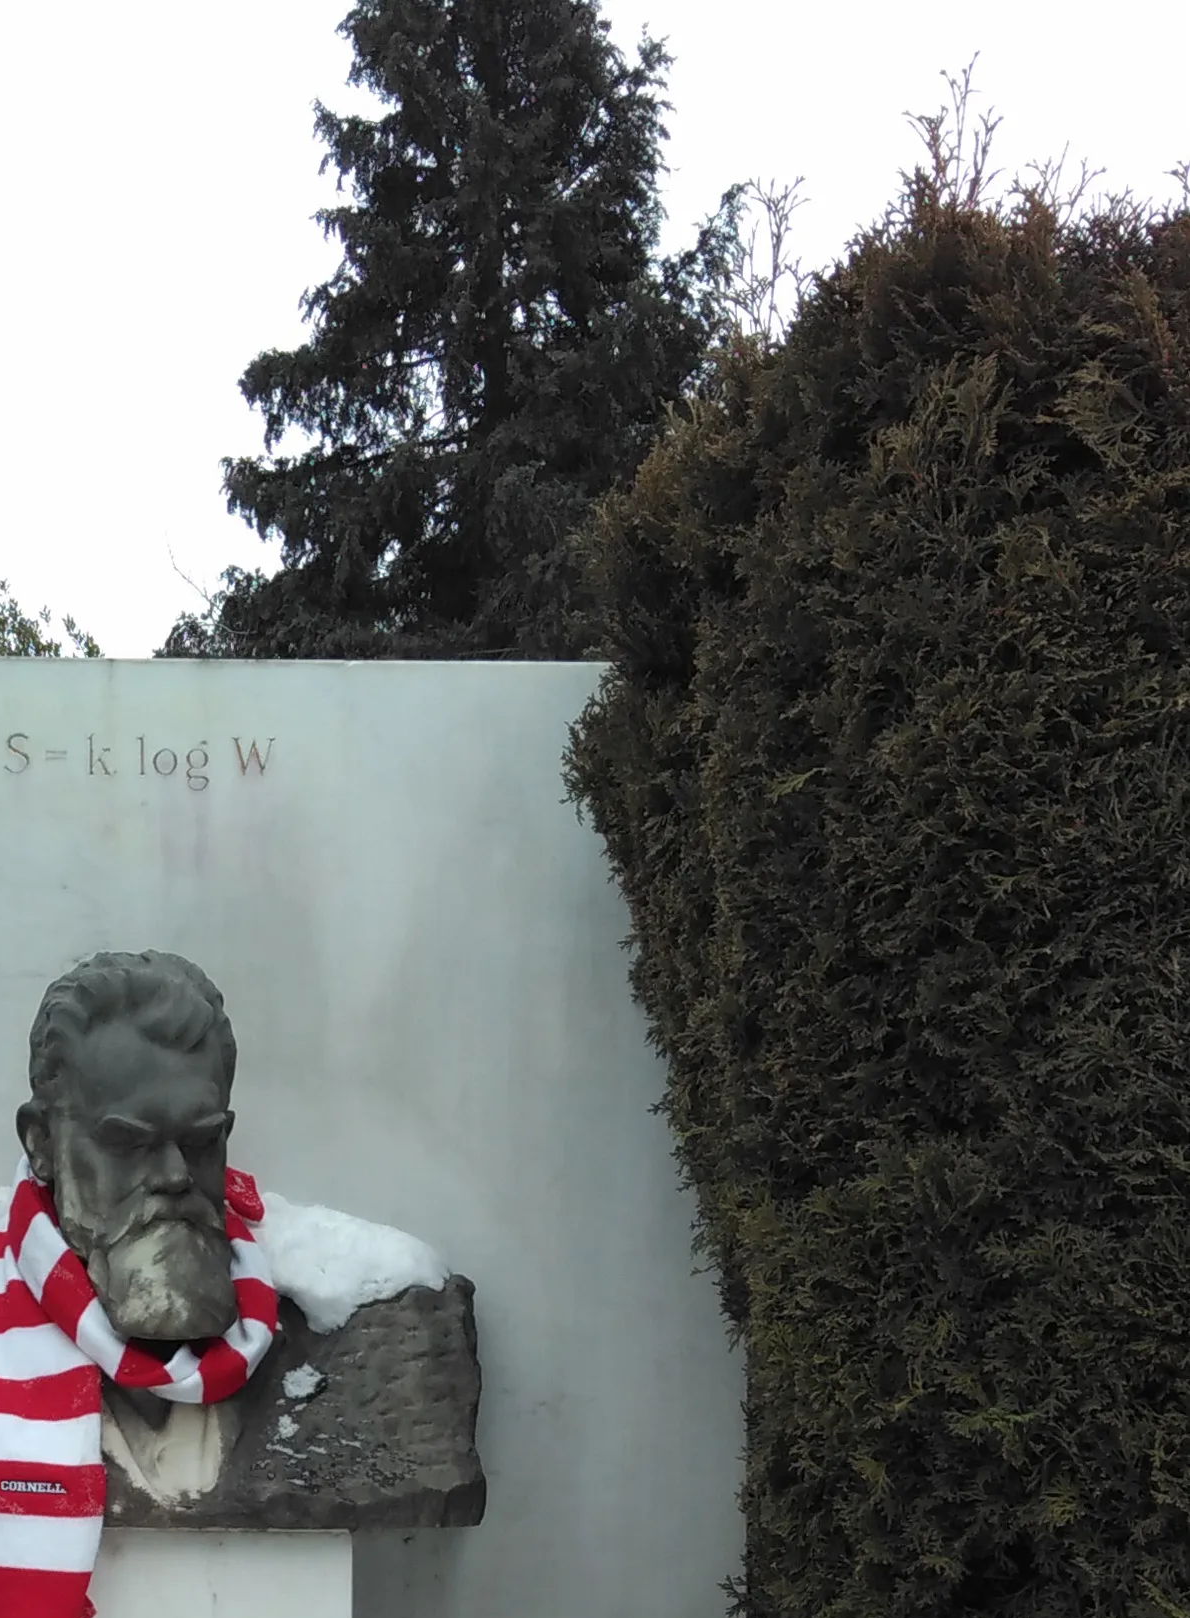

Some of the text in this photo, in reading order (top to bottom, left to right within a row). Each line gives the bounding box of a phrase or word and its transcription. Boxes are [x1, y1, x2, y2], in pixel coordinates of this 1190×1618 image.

[136, 733, 210, 792] log
[231, 736, 276, 776] W
[0, 1480, 67, 1494] CORNELL
